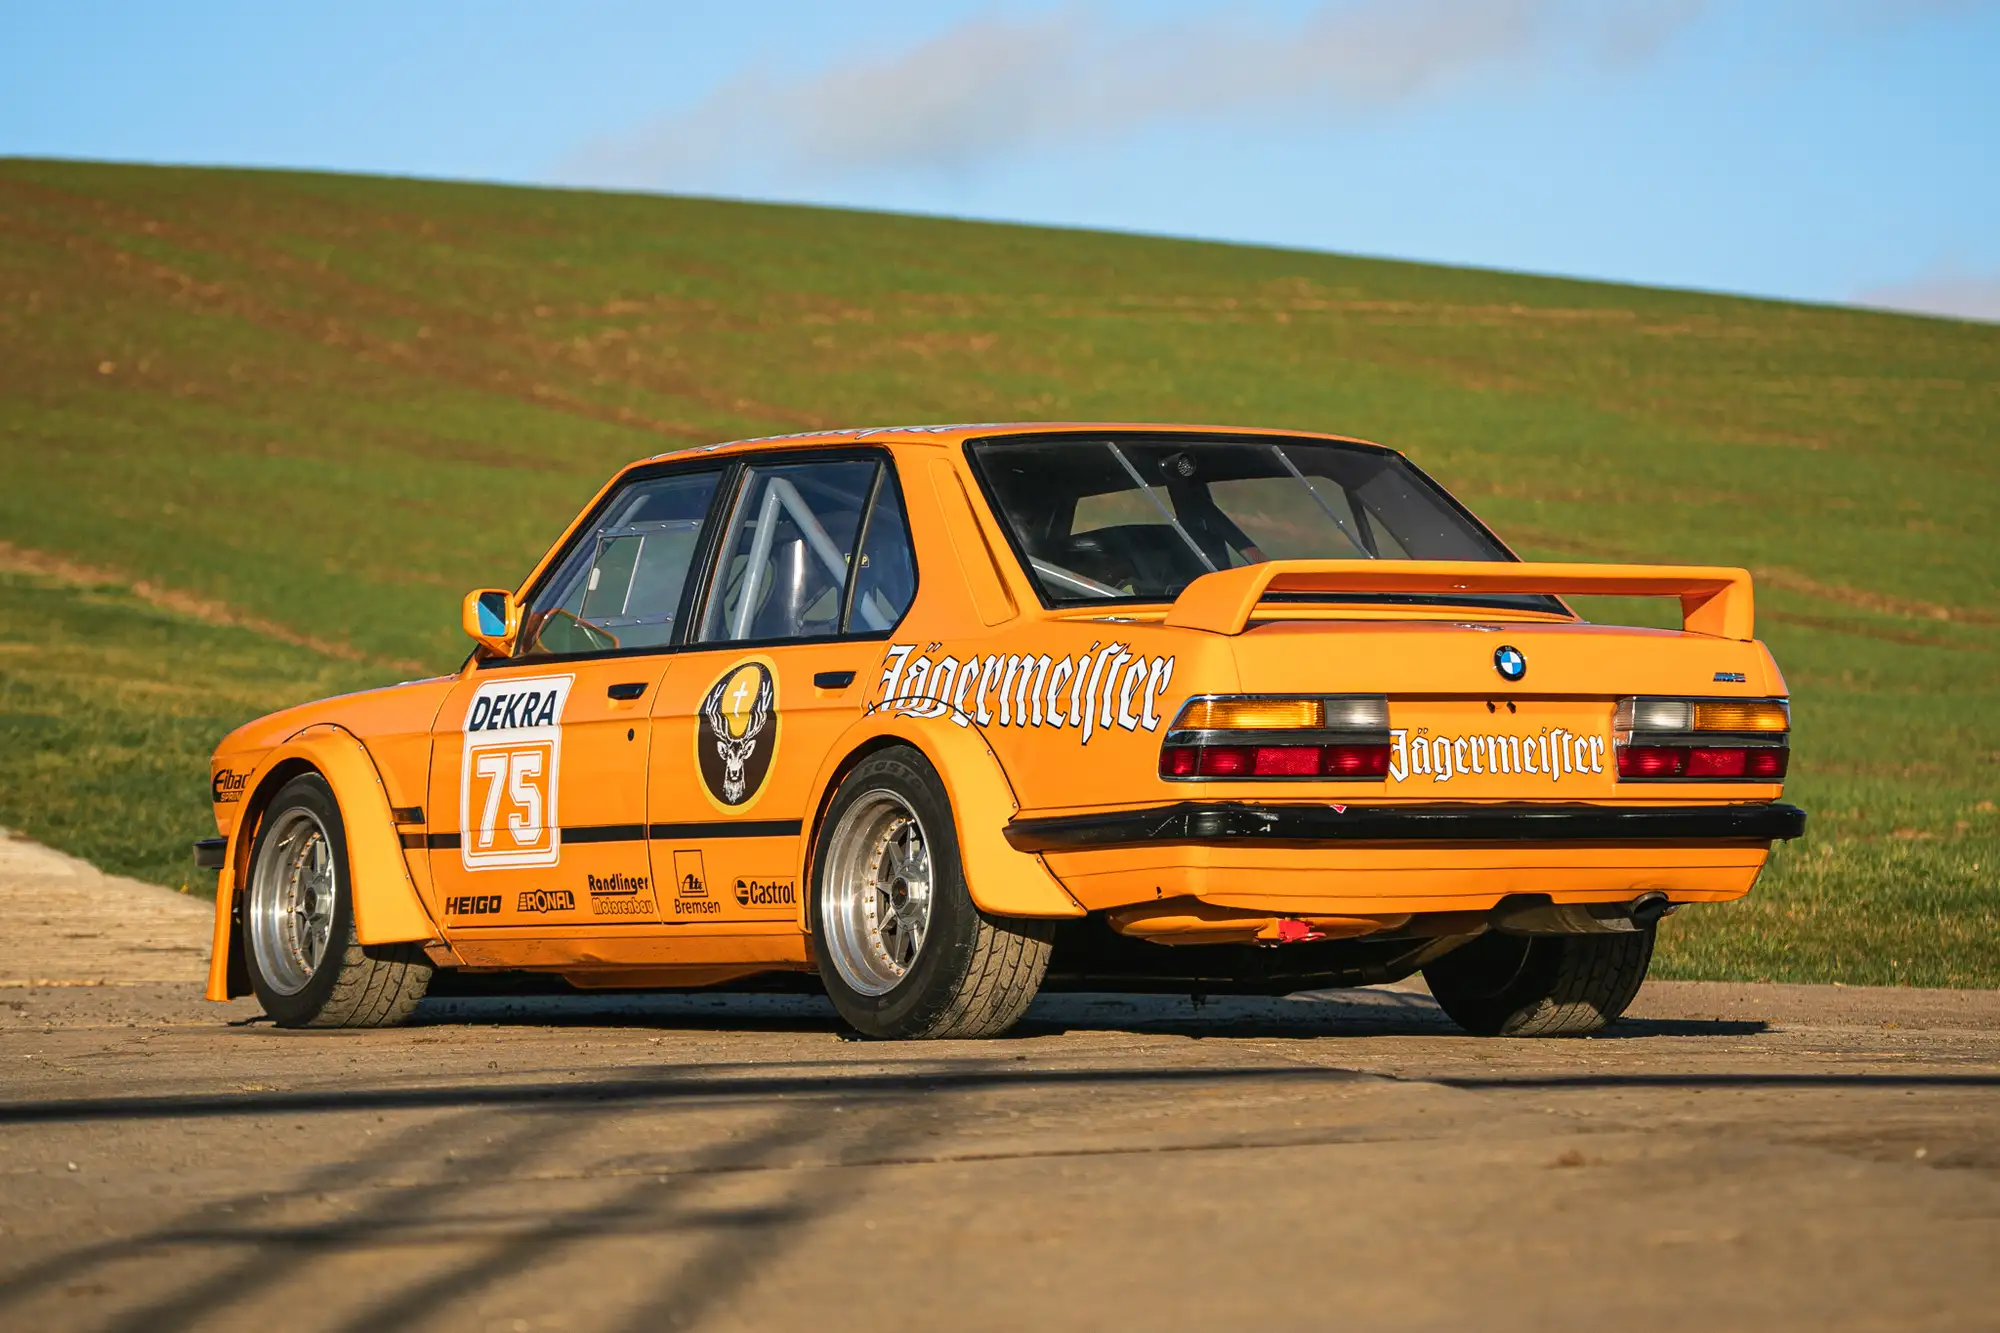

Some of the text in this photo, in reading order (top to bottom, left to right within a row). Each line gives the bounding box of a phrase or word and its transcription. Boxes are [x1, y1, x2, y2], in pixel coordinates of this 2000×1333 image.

[469, 690, 557, 732] DEKRA
[212, 767, 256, 802] Eibac
[476, 750, 543, 848] 75
[588, 873, 649, 893] Randlinger
[750, 881, 797, 905] Castrol
[445, 895, 502, 915] HEIGO
[525, 889, 576, 914] RONAL
[591, 896, 654, 915] Motorenbau
[674, 898, 721, 914] Bremsen
